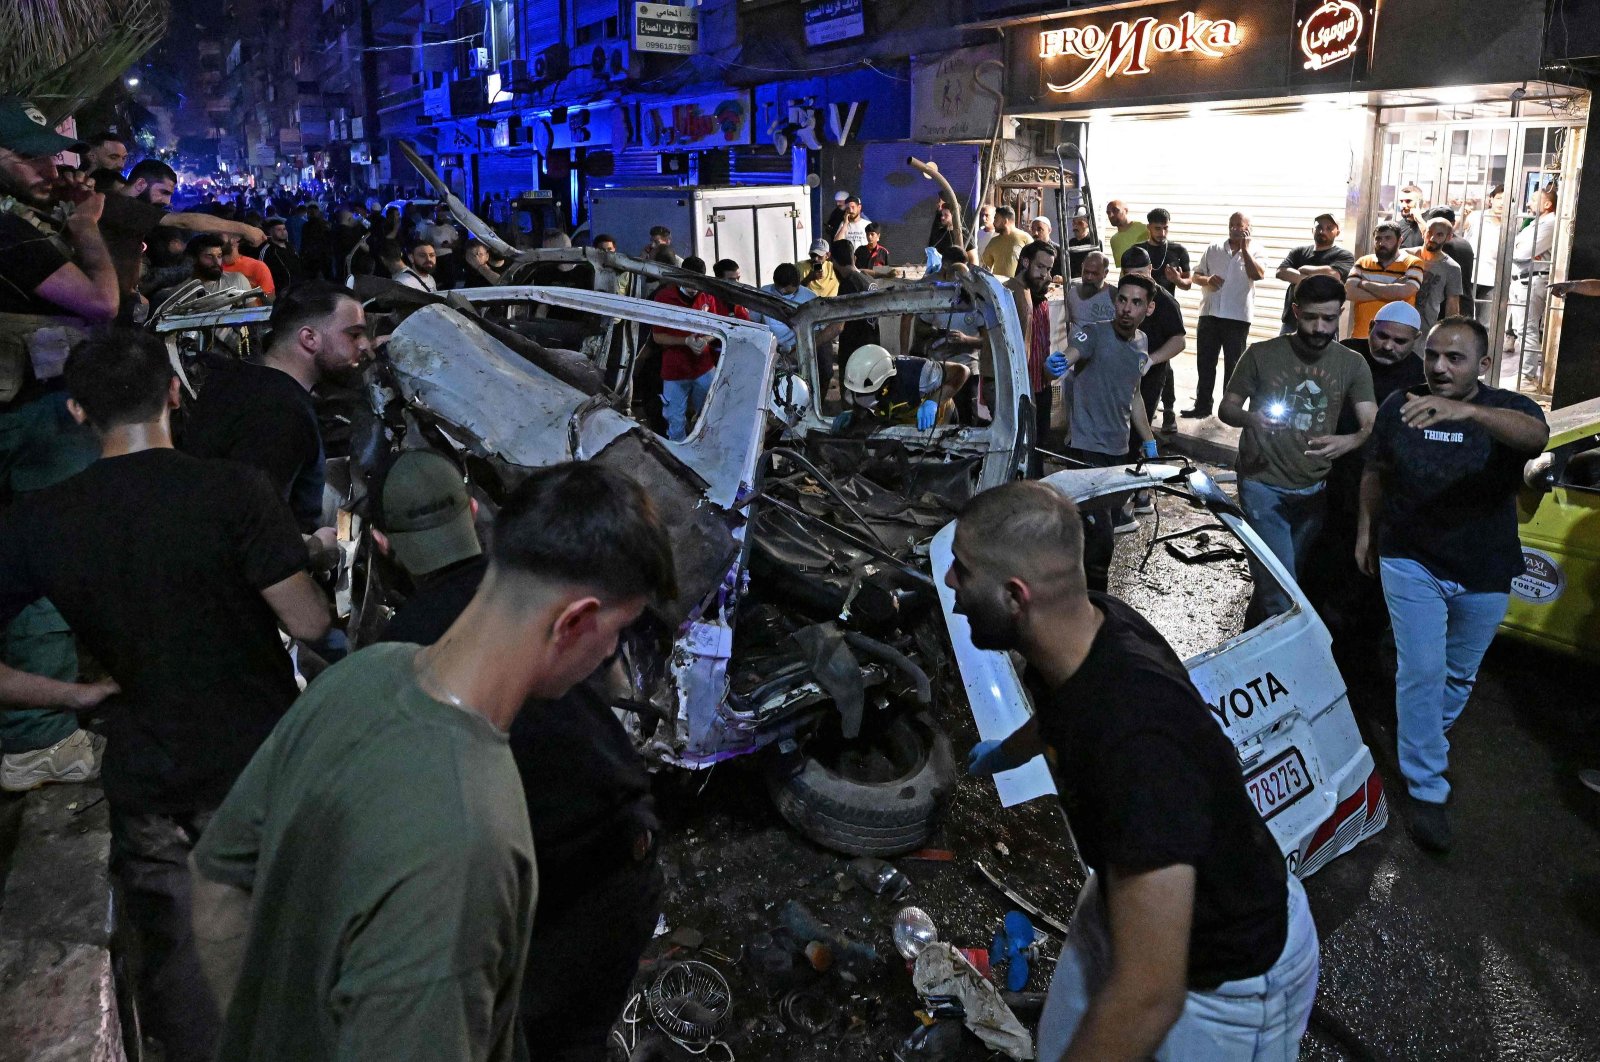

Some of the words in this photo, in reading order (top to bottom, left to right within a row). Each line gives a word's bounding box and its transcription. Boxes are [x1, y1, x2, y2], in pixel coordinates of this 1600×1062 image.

[656, 9, 682, 18] المحامي
[1424, 429, 1450, 442] THINK
[1450, 432, 1464, 443] BIG
[1208, 671, 1289, 728] YOTA
[1250, 759, 1302, 813] 78275
